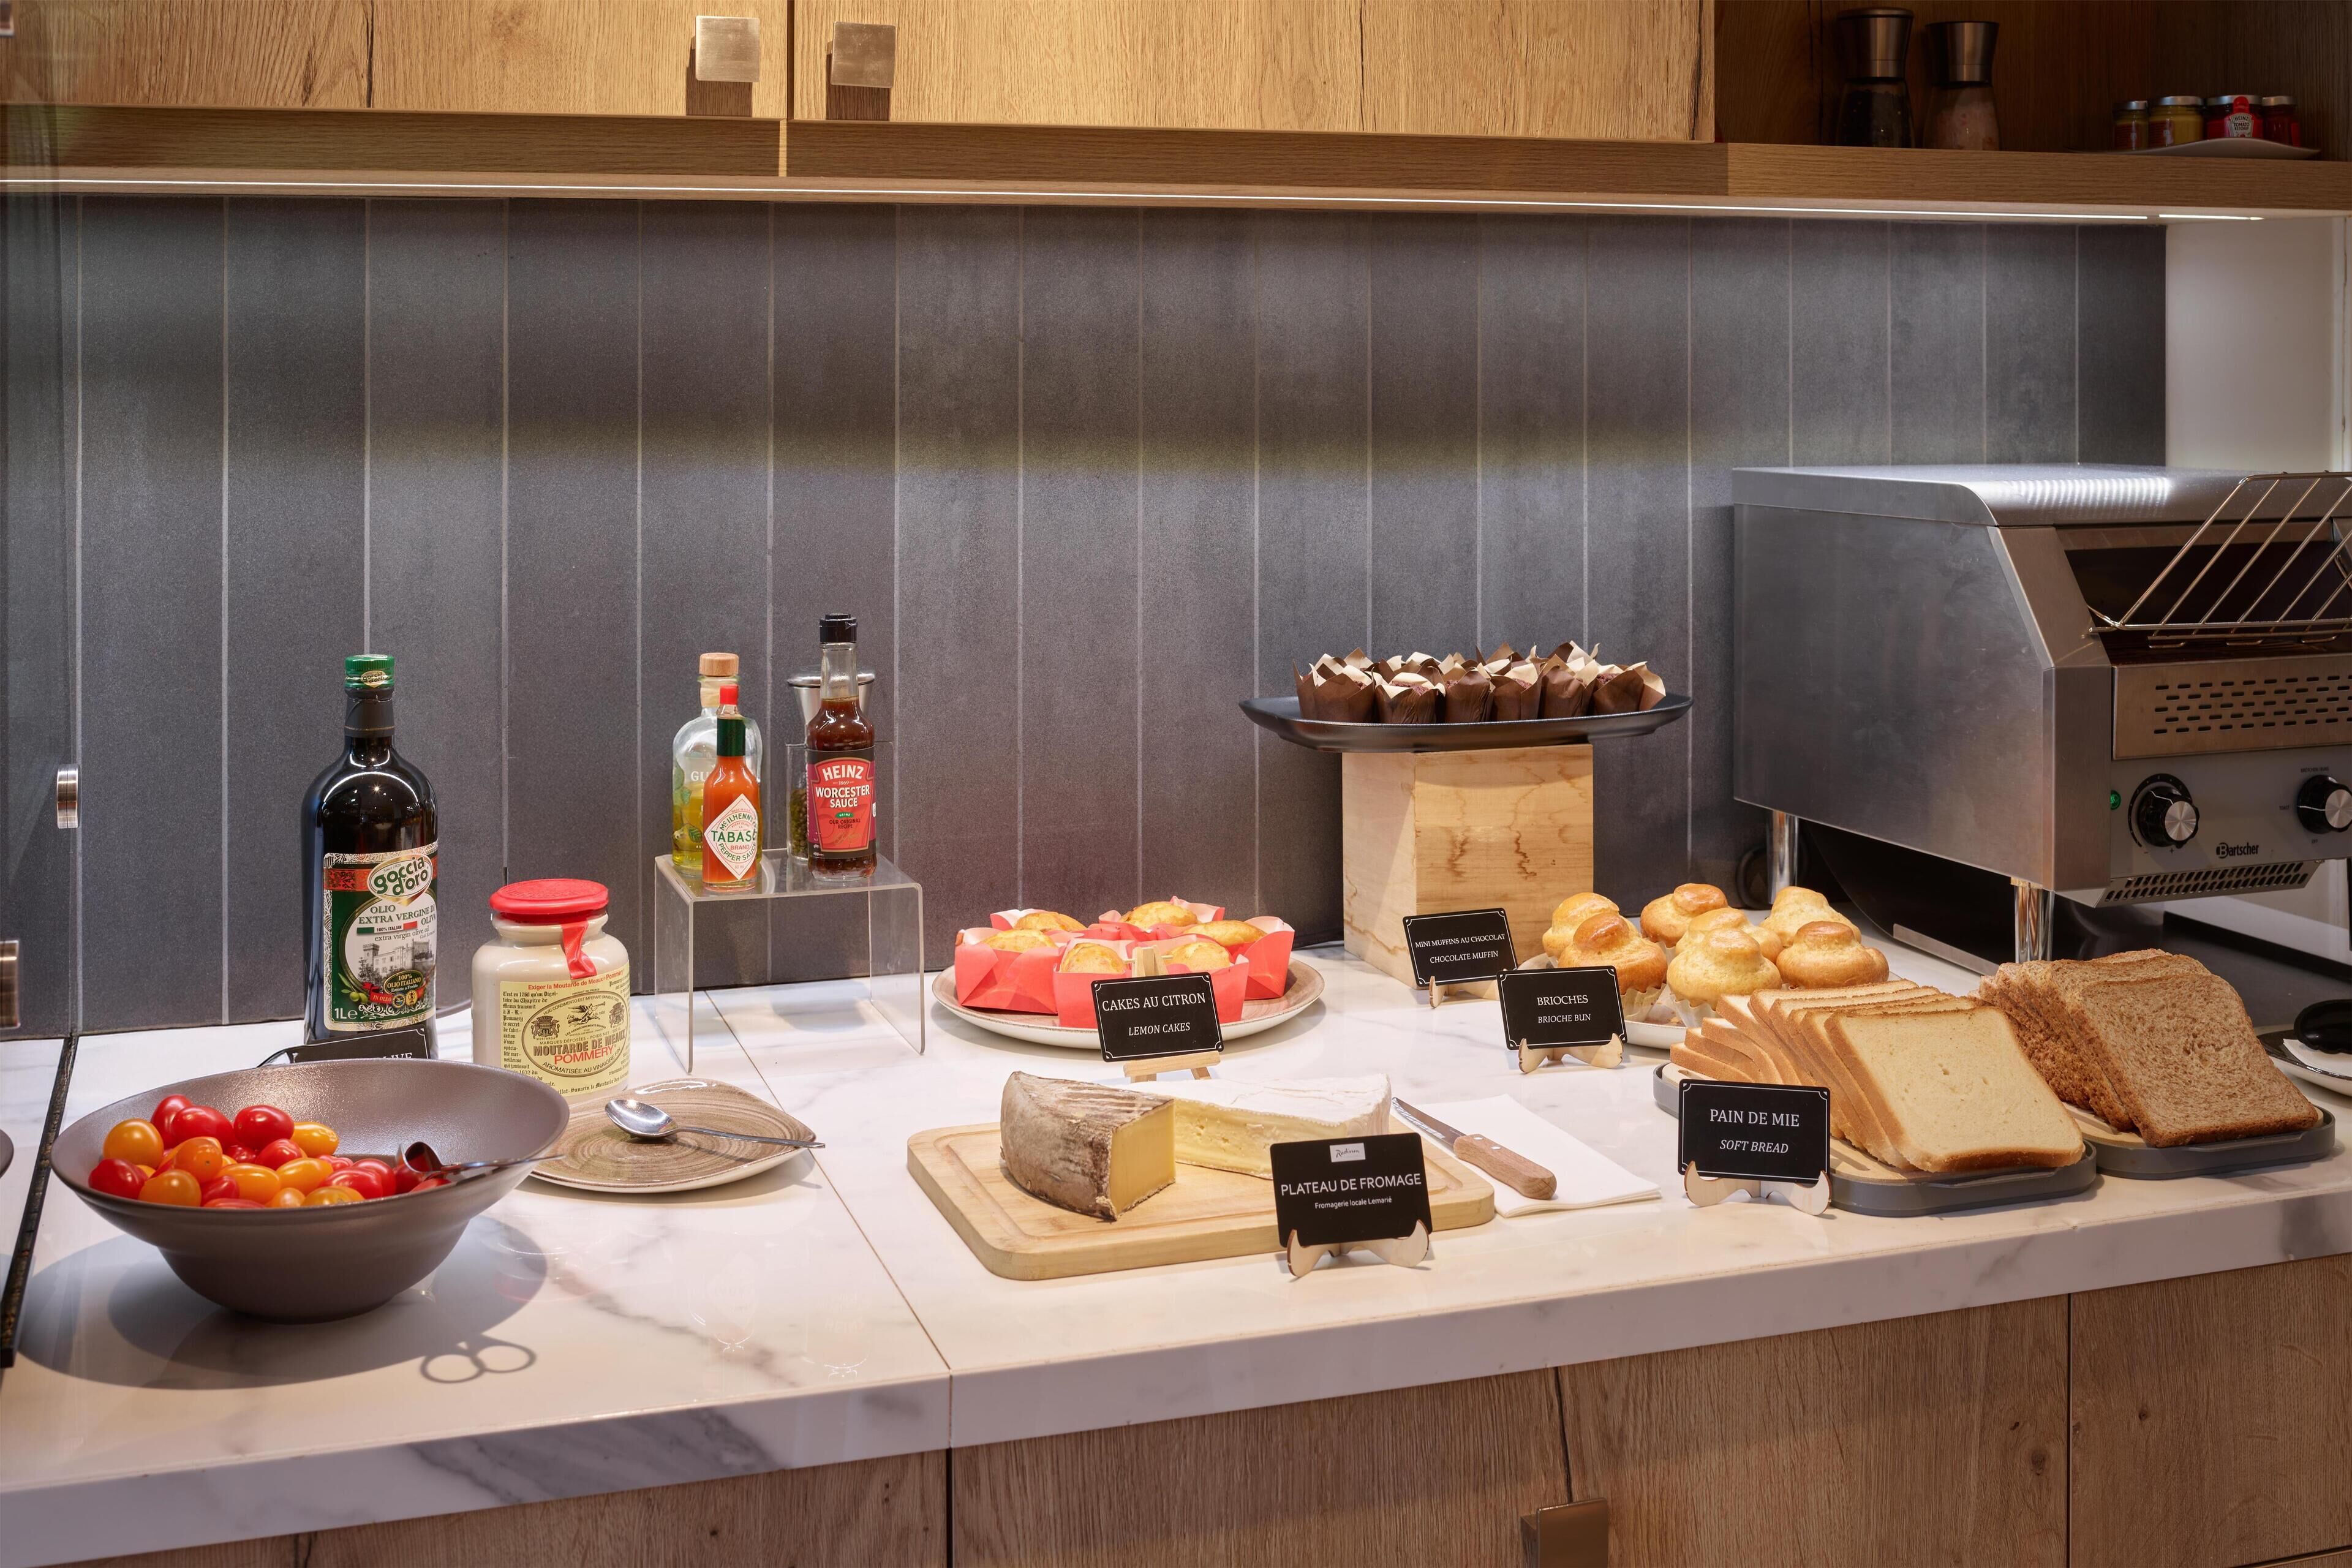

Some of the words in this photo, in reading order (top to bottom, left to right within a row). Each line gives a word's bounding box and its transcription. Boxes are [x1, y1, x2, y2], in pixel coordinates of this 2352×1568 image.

[822, 764, 864, 782] HEINZ
[815, 784, 870, 798] WORCESTER
[830, 797, 858, 808] SAUCE
[718, 843, 741, 861] PEPPER
[2216, 842, 2259, 859] Bartscher
[374, 857, 425, 894] goccia
[392, 869, 428, 895] d'oro
[358, 915, 393, 924] EXTRA
[396, 907, 430, 921] VERGINE
[371, 905, 396, 914] OLIO
[1431, 938, 1460, 946] MUFFINS
[1471, 933, 1506, 943] CHOCOLAT
[1430, 953, 1471, 963] CHOCOLATE
[1472, 951, 1499, 959] MUFFIN
[401, 977, 421, 986] ITALIANO
[1102, 998, 1140, 1011] CAKES
[1143, 997, 1158, 1008] AU
[1162, 992, 1206, 1006] CITRON
[1537, 995, 1588, 1006] BRIOCHES
[1538, 1014, 1572, 1023] BRIOCHE
[1129, 1025, 1160, 1036] LEMON
[1163, 1022, 1191, 1033] CAKES
[533, 1041, 589, 1056] MOUTARDE
[592, 1039, 602, 1047] DE
[605, 1029, 625, 1046] MEAUX
[554, 1044, 614, 1065] POMMERY
[543, 1061, 582, 1074] AROMATISÉE
[593, 1057, 615, 1071] VINAIGRE
[596, 1079, 613, 1088] Moutarde
[1709, 1109, 1744, 1123] PAIN
[1748, 1111, 1768, 1125] DE
[1772, 1113, 1800, 1127] MIE
[1719, 1139, 1749, 1151] SOFT
[1751, 1142, 1789, 1154] BREAD
[1281, 1180, 1337, 1196] PLATEAU
[1341, 1178, 1357, 1191] DE
[1360, 1173, 1422, 1189] FROMAGE
[1314, 1200, 1349, 1210] Fromagerie
[1368, 1196, 1392, 1205] Lemarié
